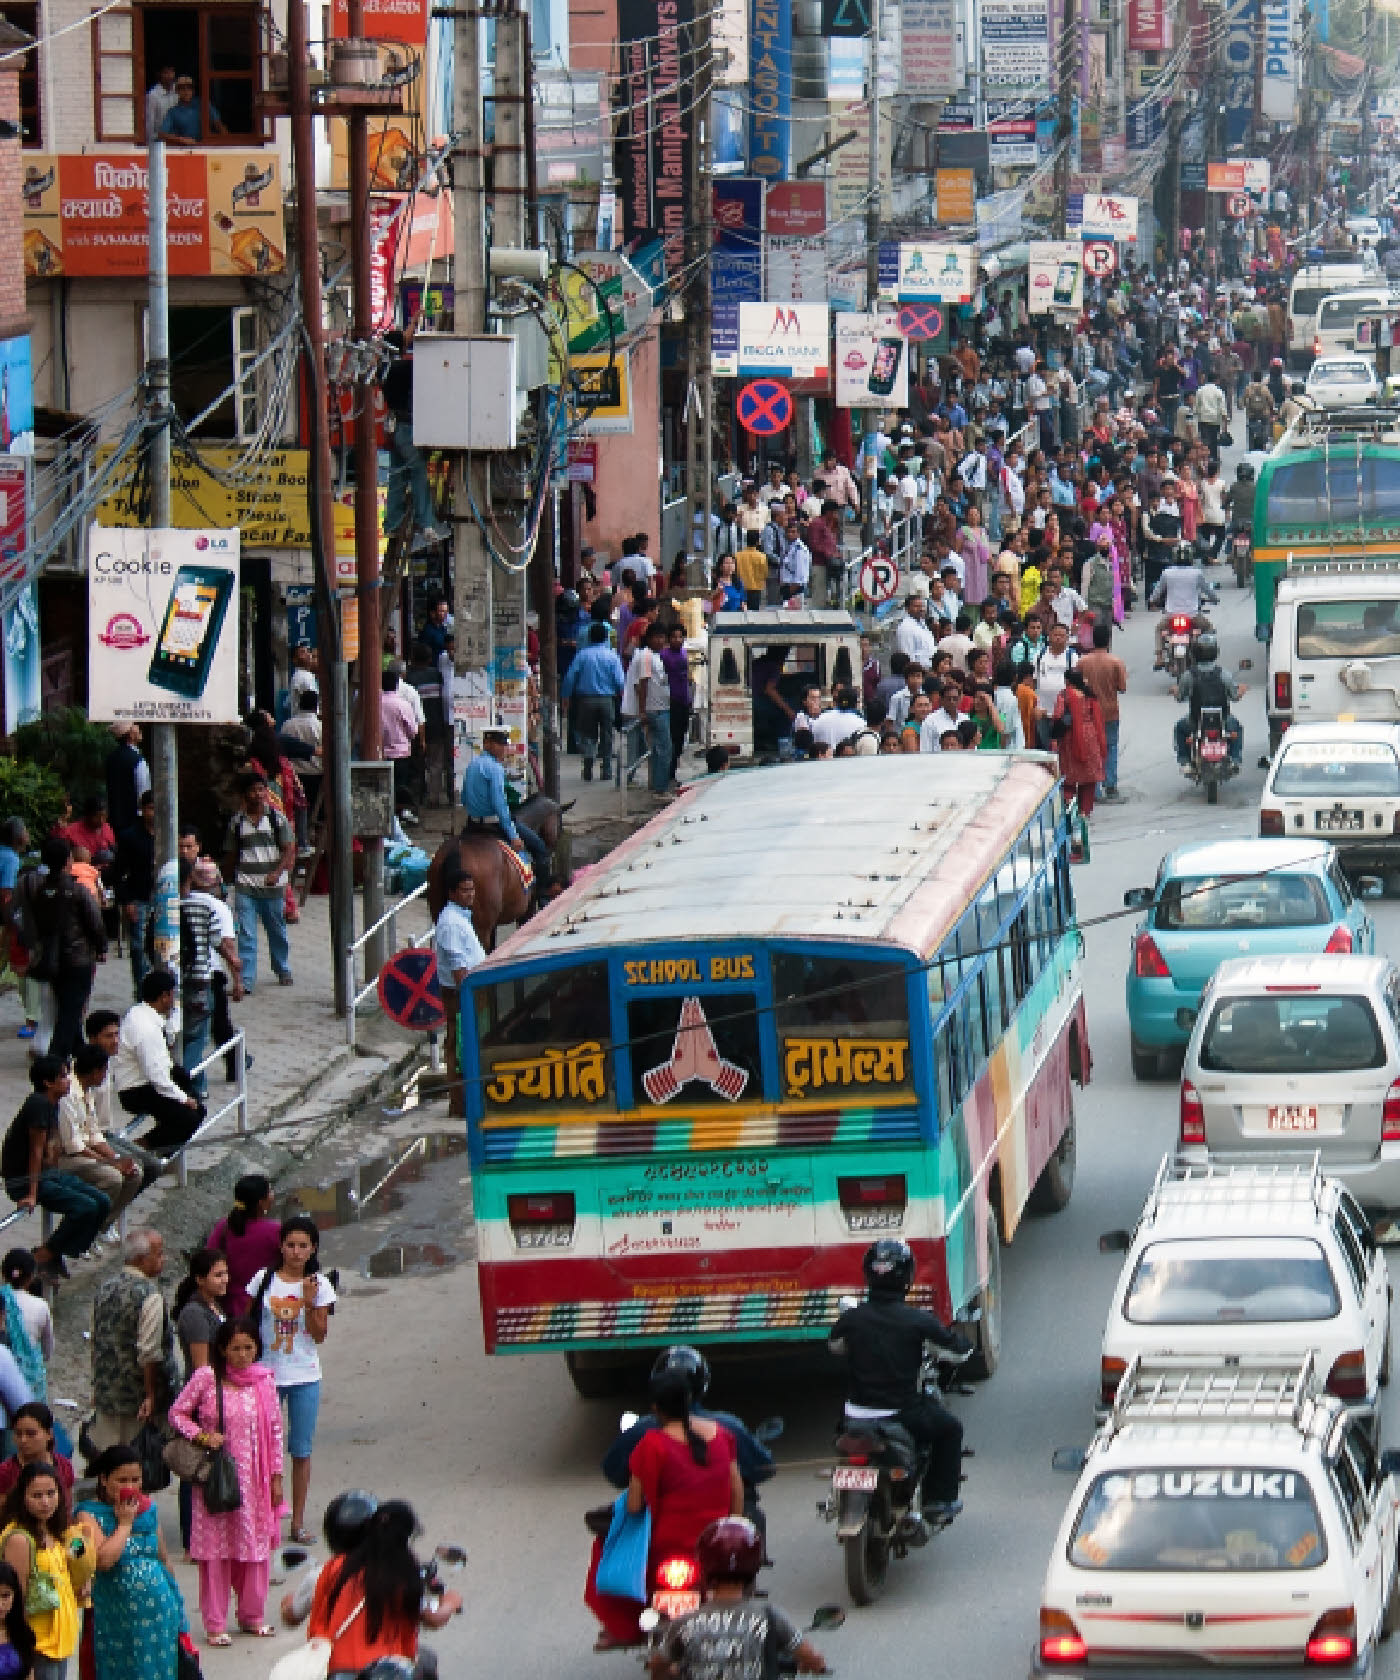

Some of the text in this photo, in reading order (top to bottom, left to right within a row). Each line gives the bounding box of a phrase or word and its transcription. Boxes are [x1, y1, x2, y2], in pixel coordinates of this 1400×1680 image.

[656, 102, 688, 198] Manipal
[211, 539, 229, 549] LG
[94, 551, 172, 576] Cookie
[623, 953, 756, 985] SCHOOL BUS
[487, 1040, 609, 1103] ज्योति
[1133, 1471, 1295, 1499] SUZUKI
